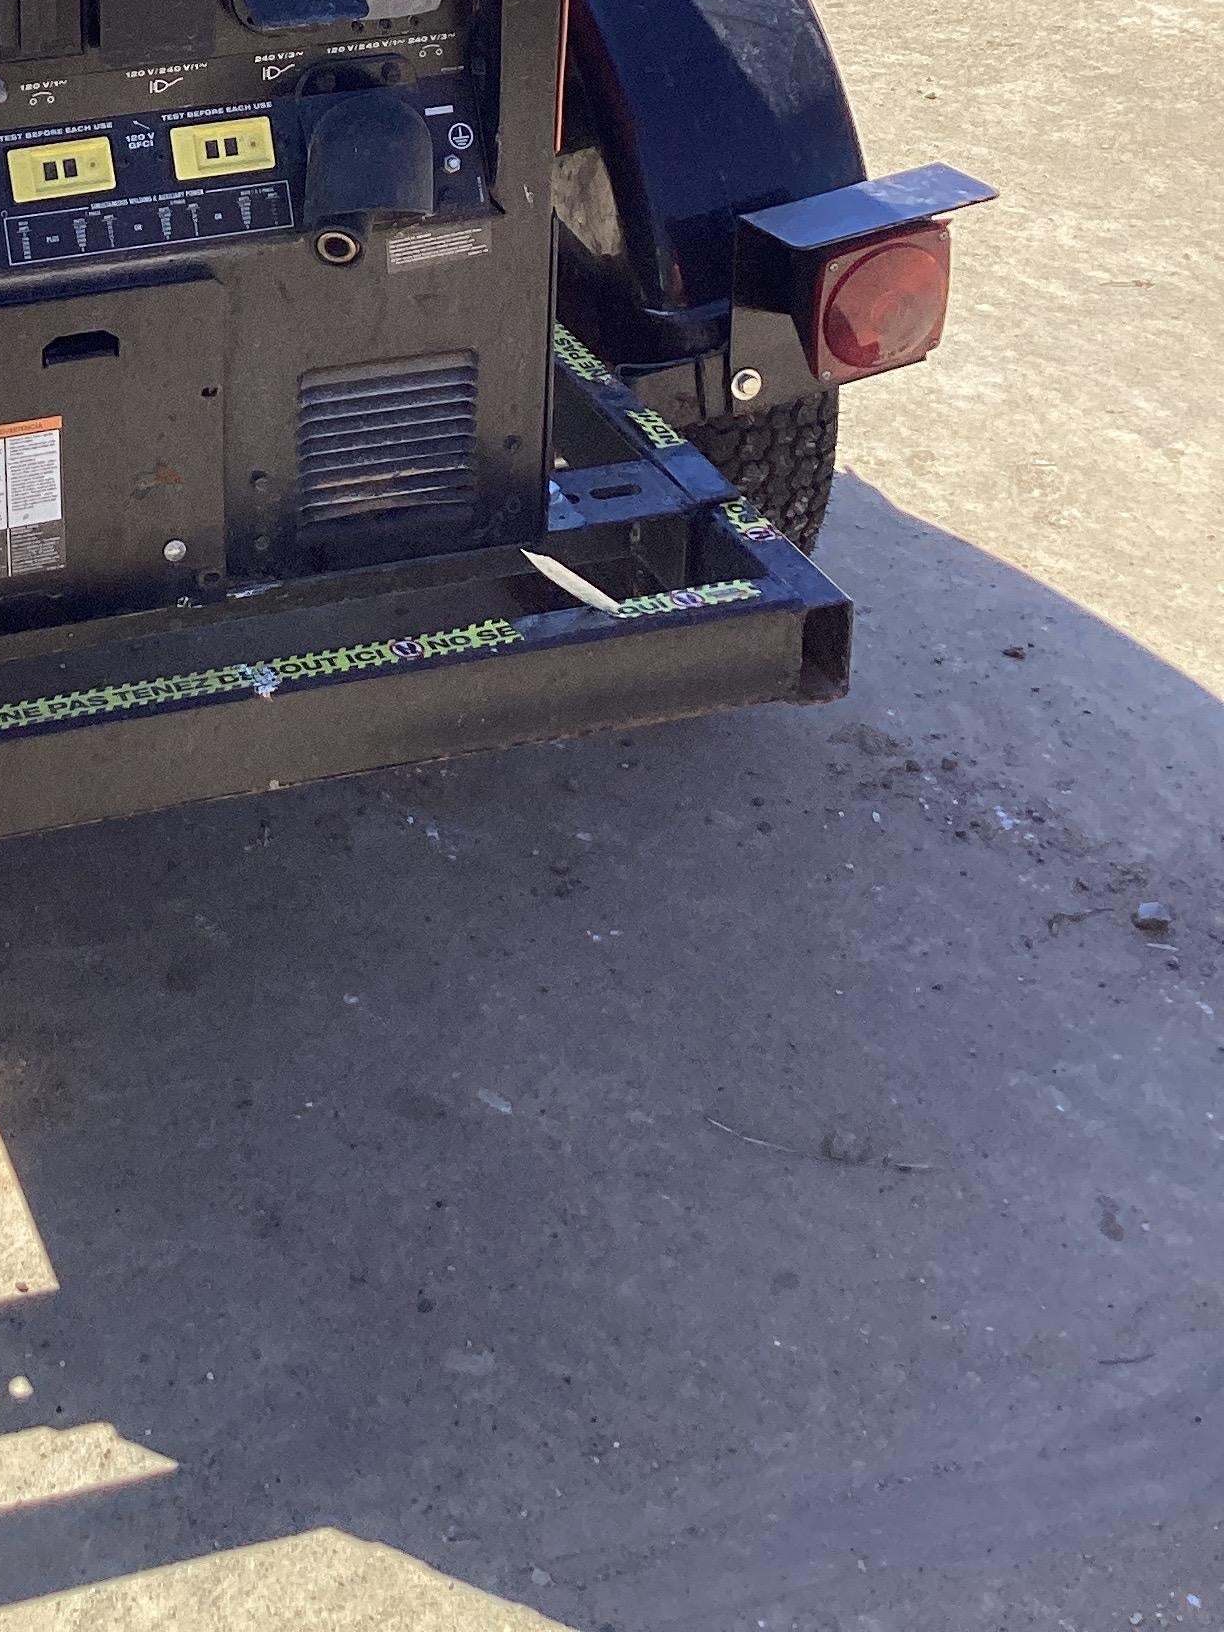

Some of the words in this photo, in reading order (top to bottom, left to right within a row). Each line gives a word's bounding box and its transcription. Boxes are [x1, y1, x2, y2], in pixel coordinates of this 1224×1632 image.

[254, 54, 276, 64] 240
[125, 69, 145, 79] 120
[20, 82, 41, 92] 120
[161, 112, 186, 122] TEST
[187, 107, 224, 119] BEFORE
[225, 104, 252, 114] EACH
[253, 101, 273, 111] USE
[25, 128, 63, 140] BEFORE
[65, 125, 92, 135] EACH
[93, 122, 113, 131] USE
[125, 133, 146, 143] 120
[146, 132, 156, 141] V
[128, 139, 154, 150] GFCI
[185, 188, 205, 199] POWER
[426, 634, 472, 650] NO
[477, 625, 518, 643] SE
[0, 706, 42, 723] NE
[46, 694, 108, 713] PAS
[111, 676, 212, 704] TENEZ
[347, 649, 386, 664] ICI
